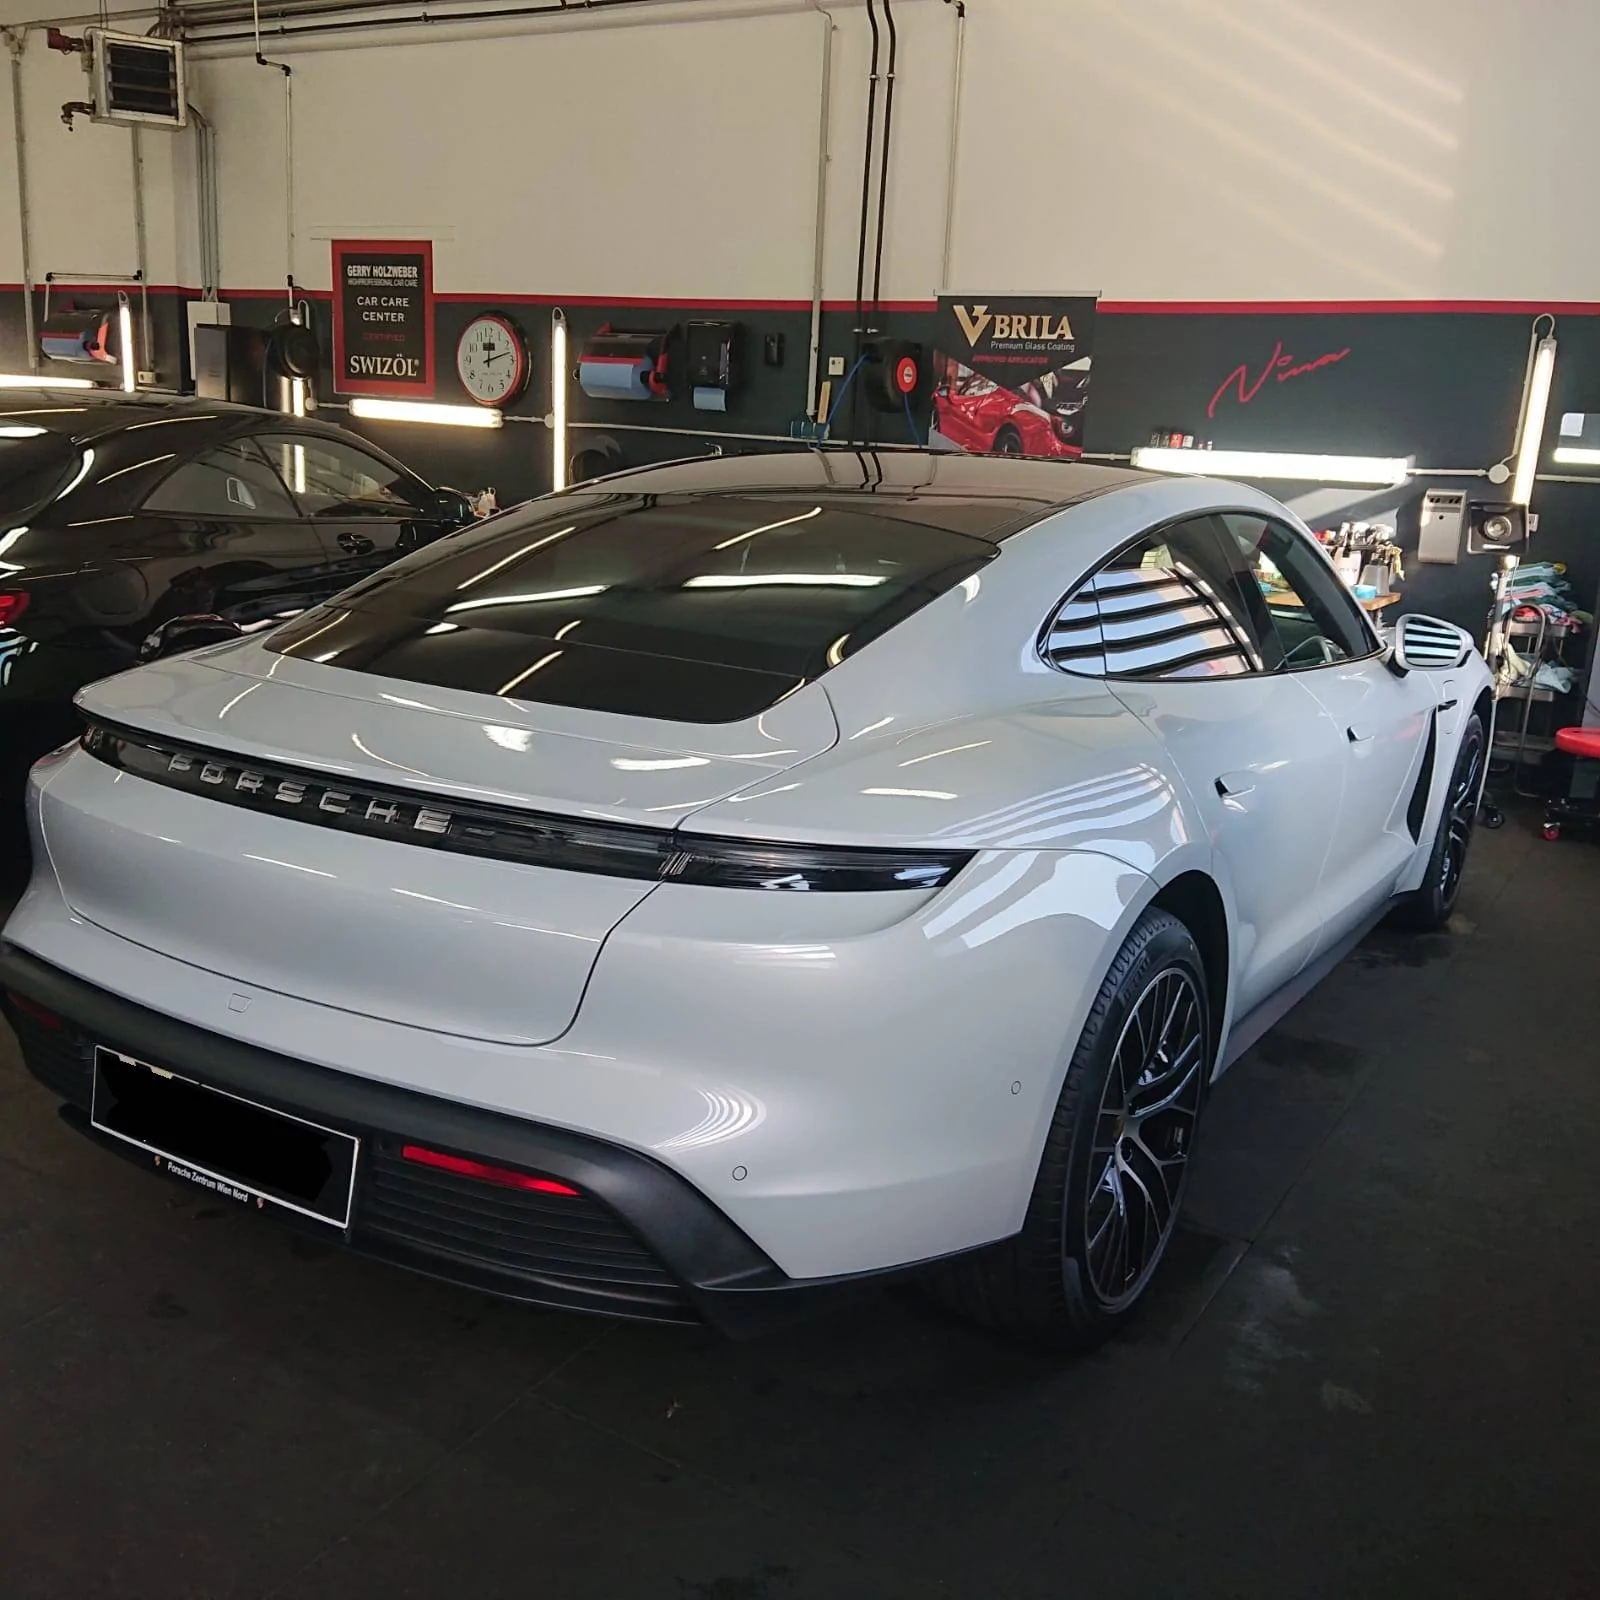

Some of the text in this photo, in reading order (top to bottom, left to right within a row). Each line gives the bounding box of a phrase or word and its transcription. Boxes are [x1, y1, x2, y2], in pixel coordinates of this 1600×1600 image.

[347, 265, 418, 278] GERRY HOLZWEBER
[357, 296, 409, 307] CAR CARE
[362, 311, 405, 322] CENTER
[992, 315, 1075, 340] BRILA
[990, 341, 1075, 352] Premium Glass Coating
[168, 753, 452, 834] PORSCHE
[167, 1161, 249, 1202] Porsche Zentrum Wien Nord
